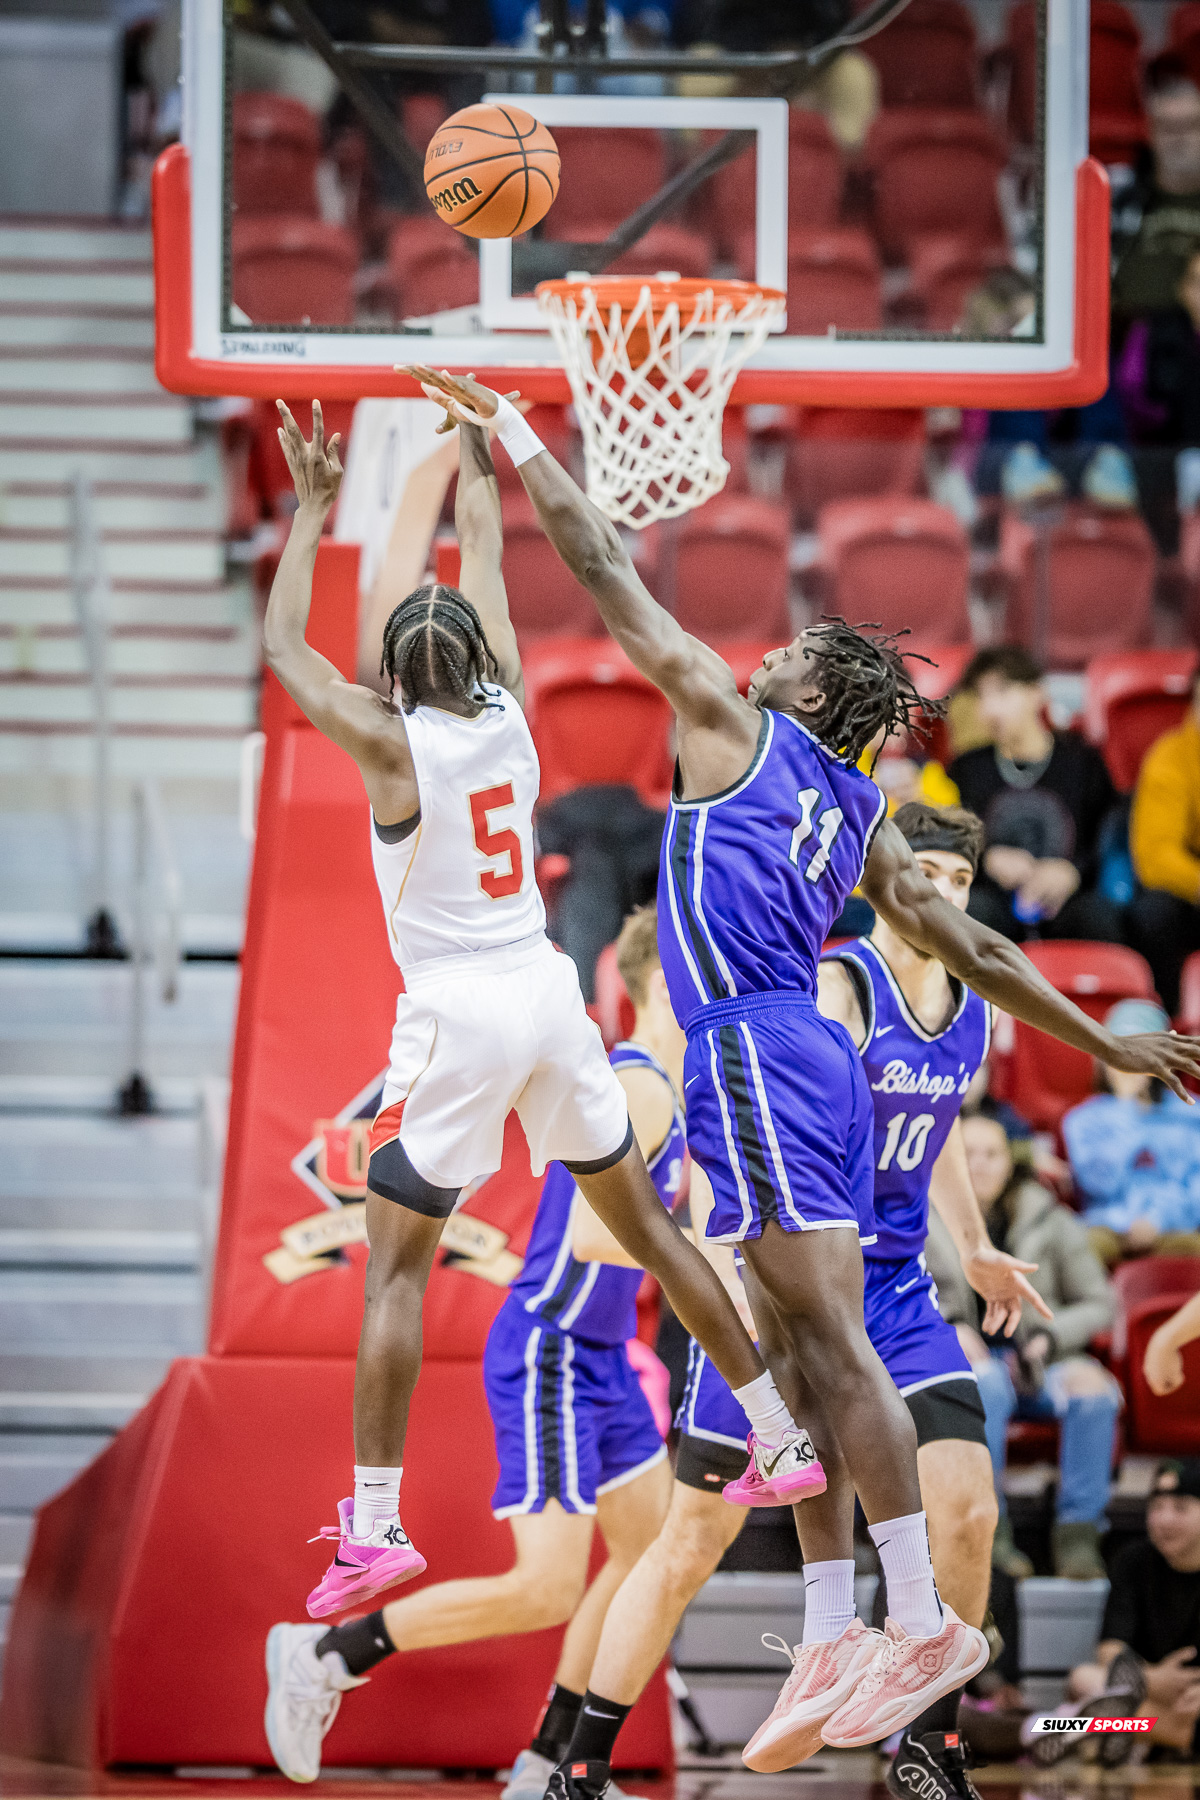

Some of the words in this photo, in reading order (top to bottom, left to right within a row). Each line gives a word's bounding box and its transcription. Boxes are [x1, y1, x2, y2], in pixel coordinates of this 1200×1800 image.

[466, 779, 524, 902] 5
[788, 786, 844, 888] 11
[871, 1059, 970, 1103] Bishop's
[877, 1112, 936, 1172] 10
